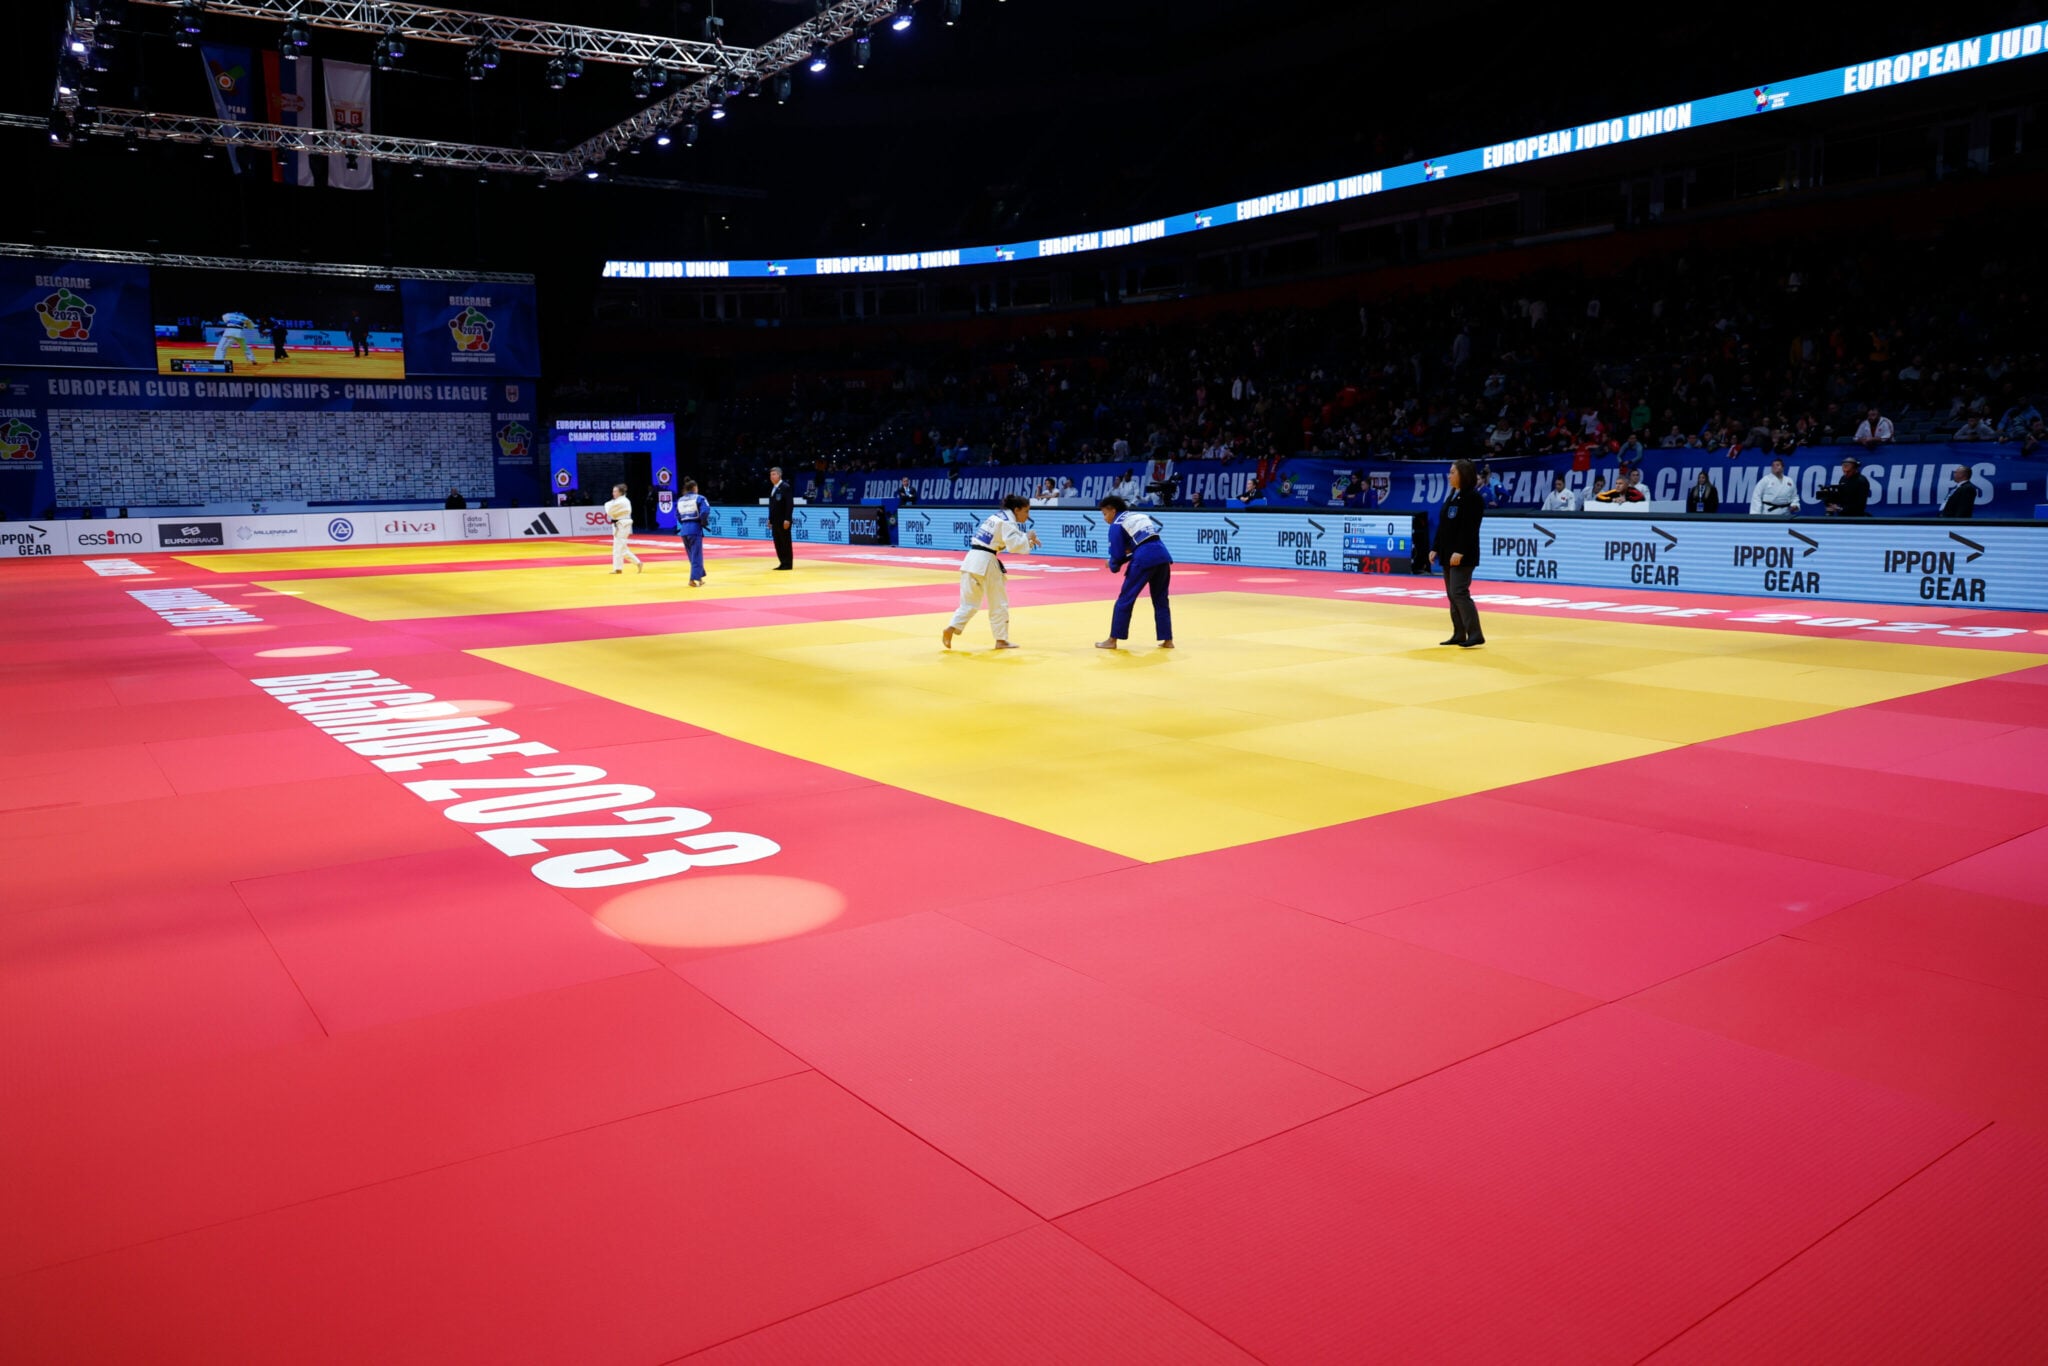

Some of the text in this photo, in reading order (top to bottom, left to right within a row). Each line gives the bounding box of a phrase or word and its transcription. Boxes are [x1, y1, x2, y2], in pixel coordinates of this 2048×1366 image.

[1843, 23, 2048, 94] EUROPEAN JUD
[1482, 102, 1691, 170] EUROPEAN JUDO UNION
[1236, 172, 1382, 220] EUROPEAN JUDO UNION
[1039, 232, 1098, 256] EUROPEAN
[1101, 228, 1131, 248] JUDO
[1132, 220, 1165, 243] UNION
[648, 261, 684, 278] JUDO
[686, 262, 729, 278] UNION
[816, 249, 960, 274] EUROPEAN JUDO UNION
[35, 275, 93, 290] BELGRADE
[449, 296, 492, 308] BELGRADE
[54, 311, 78, 320] 2023
[48, 378, 140, 396] EUROPEAN
[146, 380, 190, 398] CLUB
[194, 381, 330, 399] CHAMPIONSHIPS
[344, 383, 433, 400] CHAMPIONS
[437, 385, 488, 401] LEAGUE
[556, 420, 666, 430] EUROPEAN CLUB CHAMPIONSHIPS
[568, 432, 610, 442] CHAMPIONS
[610, 432, 634, 442] LEAGUE
[640, 432, 657, 442] 2023
[920, 479, 951, 500] CLUB
[385, 520, 436, 534] diva
[820, 518, 835, 530] IPPON
[906, 520, 924, 532] IPPON
[953, 522, 973, 534] IPPON
[1062, 524, 1086, 538] IPPON
[1388, 522, 1394, 536] 0
[78, 530, 142, 546] essimo
[164, 536, 219, 544] EUROBRAVO
[796, 530, 808, 540] GEAR
[828, 530, 842, 542] GEAR
[916, 534, 932, 545] GEAR
[1198, 529, 1228, 544] IPPON
[1278, 531, 1312, 548] IPPON
[18, 544, 52, 556] GEAR
[1075, 540, 1098, 554] GEAR
[1387, 538, 1394, 551] 0
[1492, 538, 1538, 557] IPPON
[1604, 541, 1656, 562] IPPON
[1213, 546, 1242, 562] GEAR
[1296, 550, 1327, 567] GEAR
[1734, 546, 1794, 568] IPPON
[1884, 550, 1955, 574] IPPON
[1362, 556, 1392, 574] 2:16
[1516, 559, 1558, 578] GEAR
[1631, 564, 1679, 586] GEAR
[1764, 570, 1820, 593] GEAR
[1920, 576, 1986, 602] GEAR
[1724, 614, 2028, 638] 2023
[250, 669, 782, 889] BELGRADE 2023
